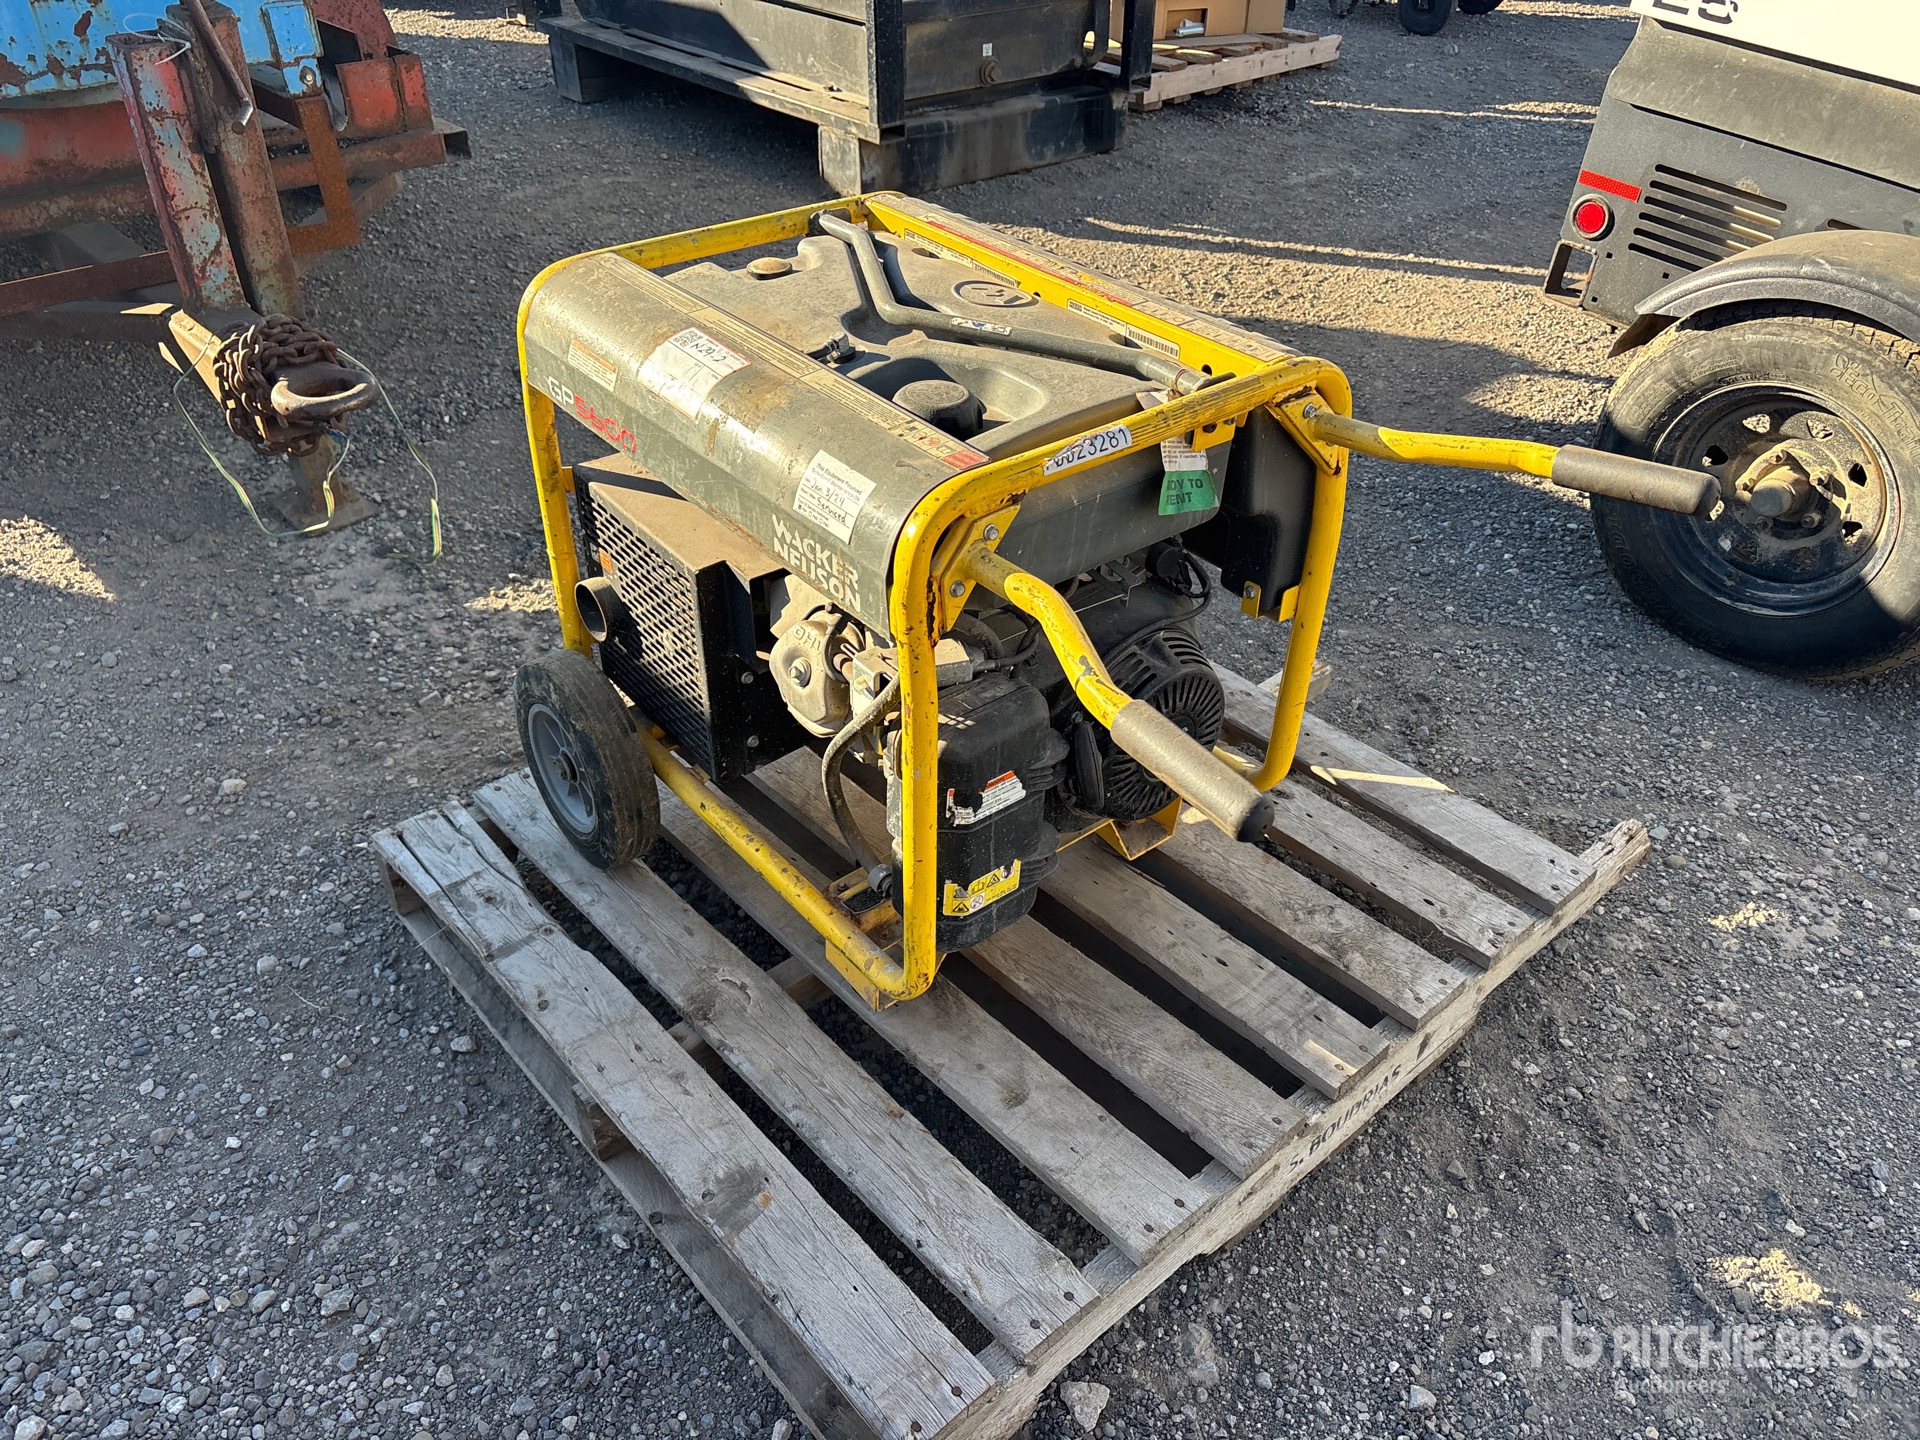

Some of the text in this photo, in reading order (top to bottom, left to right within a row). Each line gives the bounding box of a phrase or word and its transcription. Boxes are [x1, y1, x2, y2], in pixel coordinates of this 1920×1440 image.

[1187, 478, 1204, 489] TO
[817, 496, 847, 526] Serviced
[772, 513, 859, 591] WACKER
[773, 536, 861, 613] NEUSON
